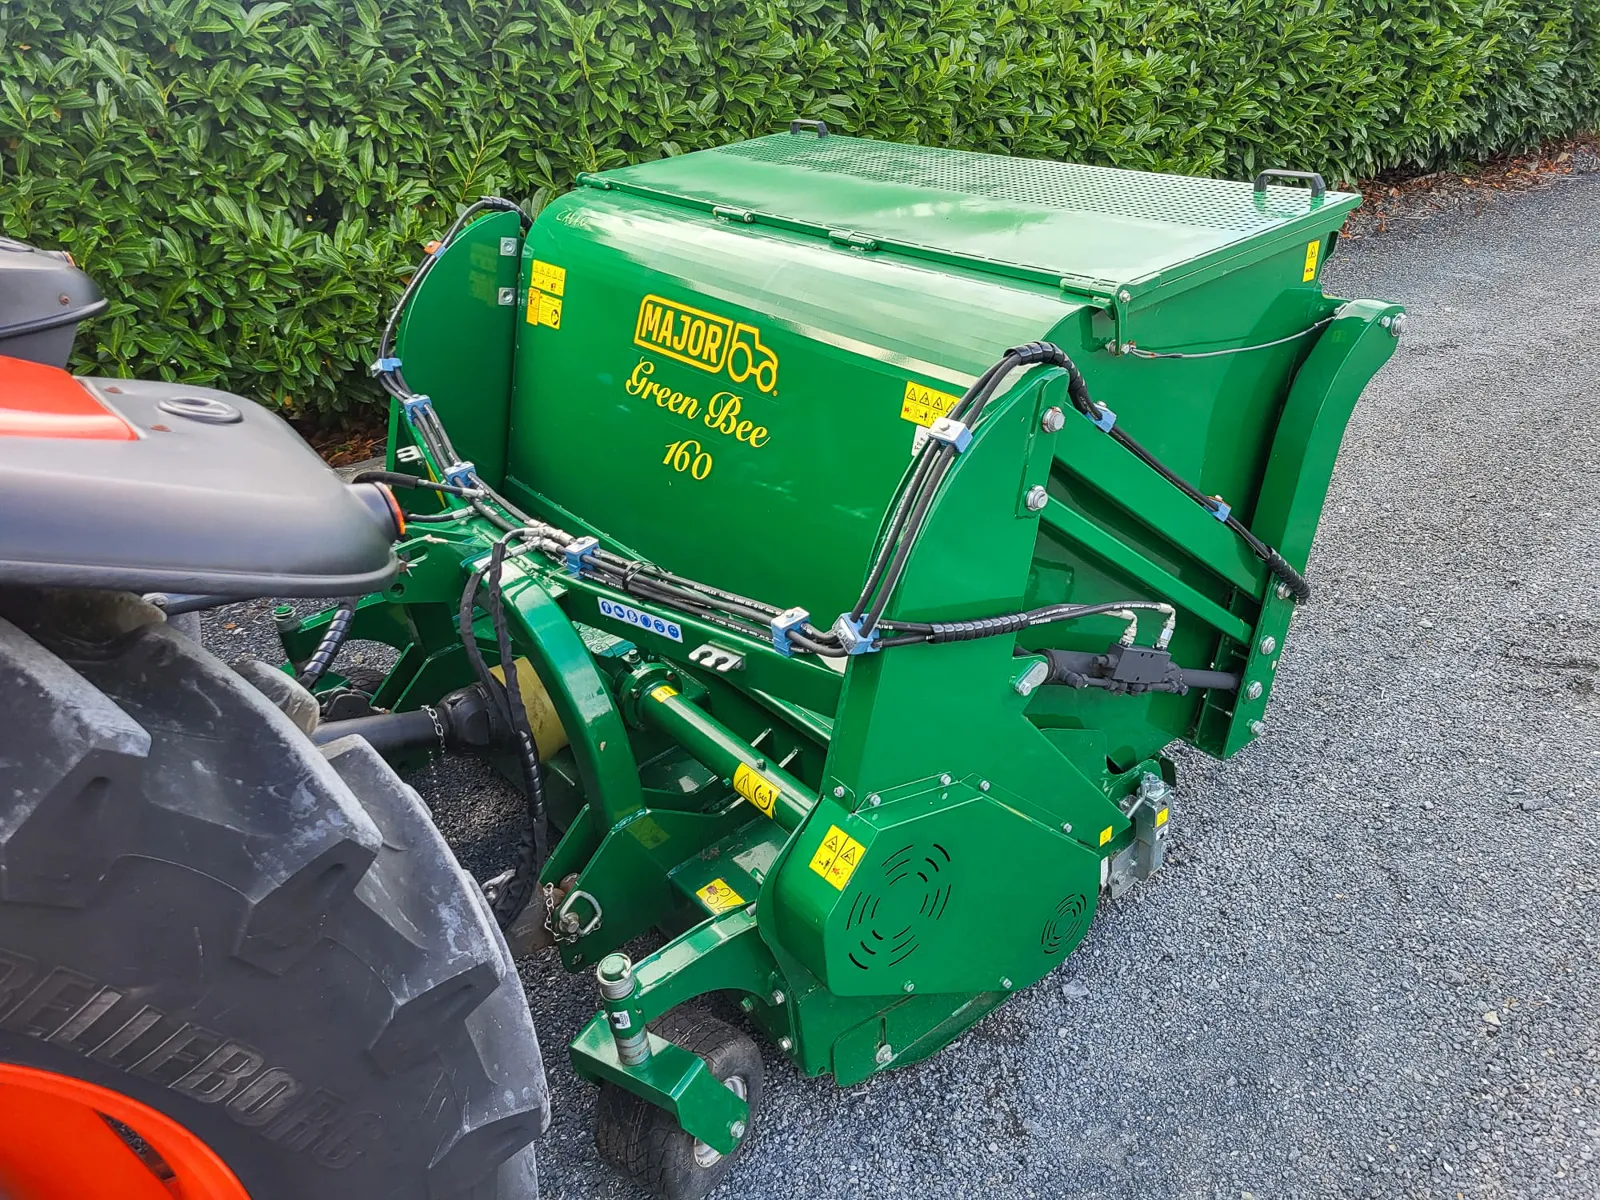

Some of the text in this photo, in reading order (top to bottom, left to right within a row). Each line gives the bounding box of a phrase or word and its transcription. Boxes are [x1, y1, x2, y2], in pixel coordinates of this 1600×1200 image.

[641, 303, 723, 364] MAJOR
[625, 356, 771, 448] Green Bee
[662, 440, 713, 480] 160
